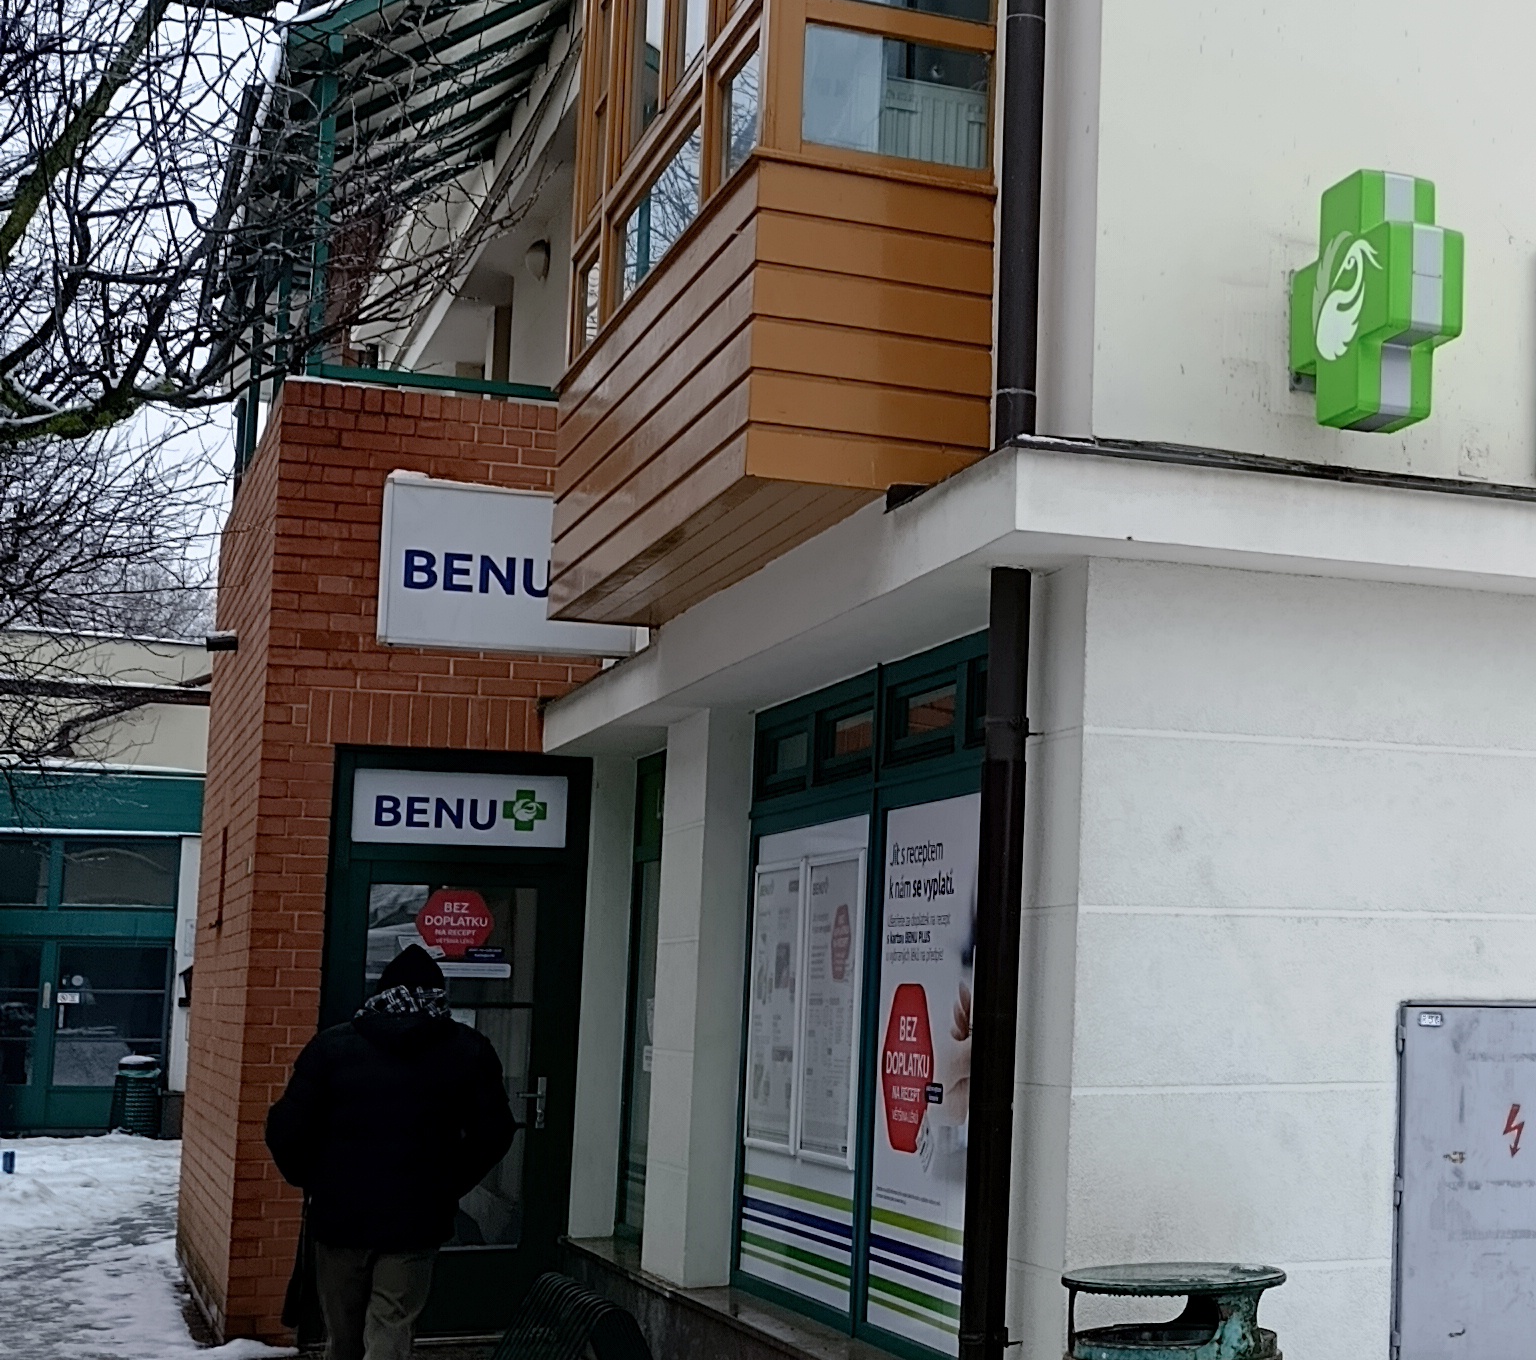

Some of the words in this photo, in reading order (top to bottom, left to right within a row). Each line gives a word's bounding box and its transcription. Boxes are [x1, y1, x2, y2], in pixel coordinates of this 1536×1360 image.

[403, 549, 551, 598] BENU
[374, 794, 497, 830] BENU
[900, 849, 905, 865] s
[906, 840, 944, 867] receptem
[889, 875, 894, 899] k
[895, 874, 912, 899] nám
[912, 878, 922, 898] se
[444, 902, 470, 913] BEZ
[425, 915, 488, 927] DOPLATKU
[434, 928, 447, 936] NA
[447, 929, 477, 937] RECEPT
[899, 1016, 918, 1042] BEZ
[886, 1051, 930, 1078] DOPLATKU
